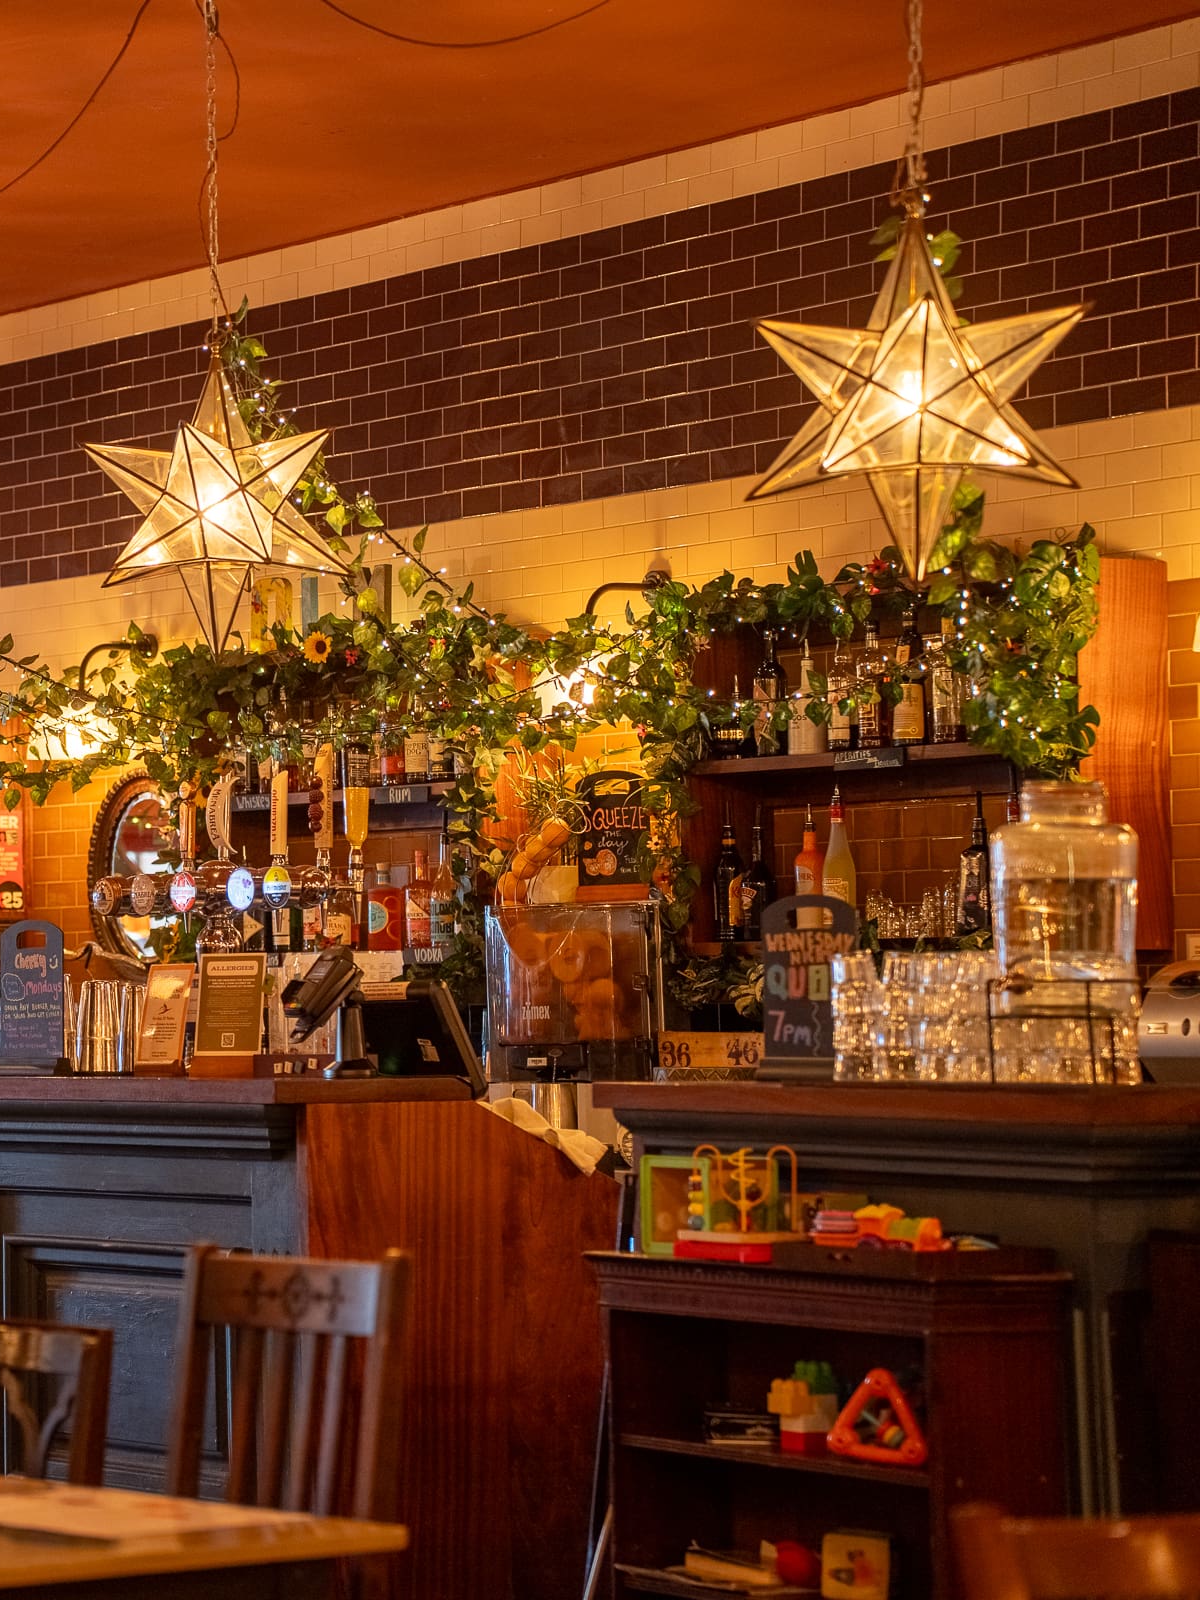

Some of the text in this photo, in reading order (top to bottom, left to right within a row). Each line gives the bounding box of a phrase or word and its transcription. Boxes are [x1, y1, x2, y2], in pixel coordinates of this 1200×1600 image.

[388, 787, 412, 803] RUM
[580, 803, 647, 833] SQUEEZE
[604, 830, 622, 838] THE
[598, 837, 629, 855] day
[1, 891, 24, 909] 25
[764, 931, 856, 953] WEDNESDAY
[14, 952, 47, 977] Cheeky
[413, 947, 444, 963] VODKA
[25, 980, 63, 1001] Mondays
[661, 1041, 692, 1068] 36
